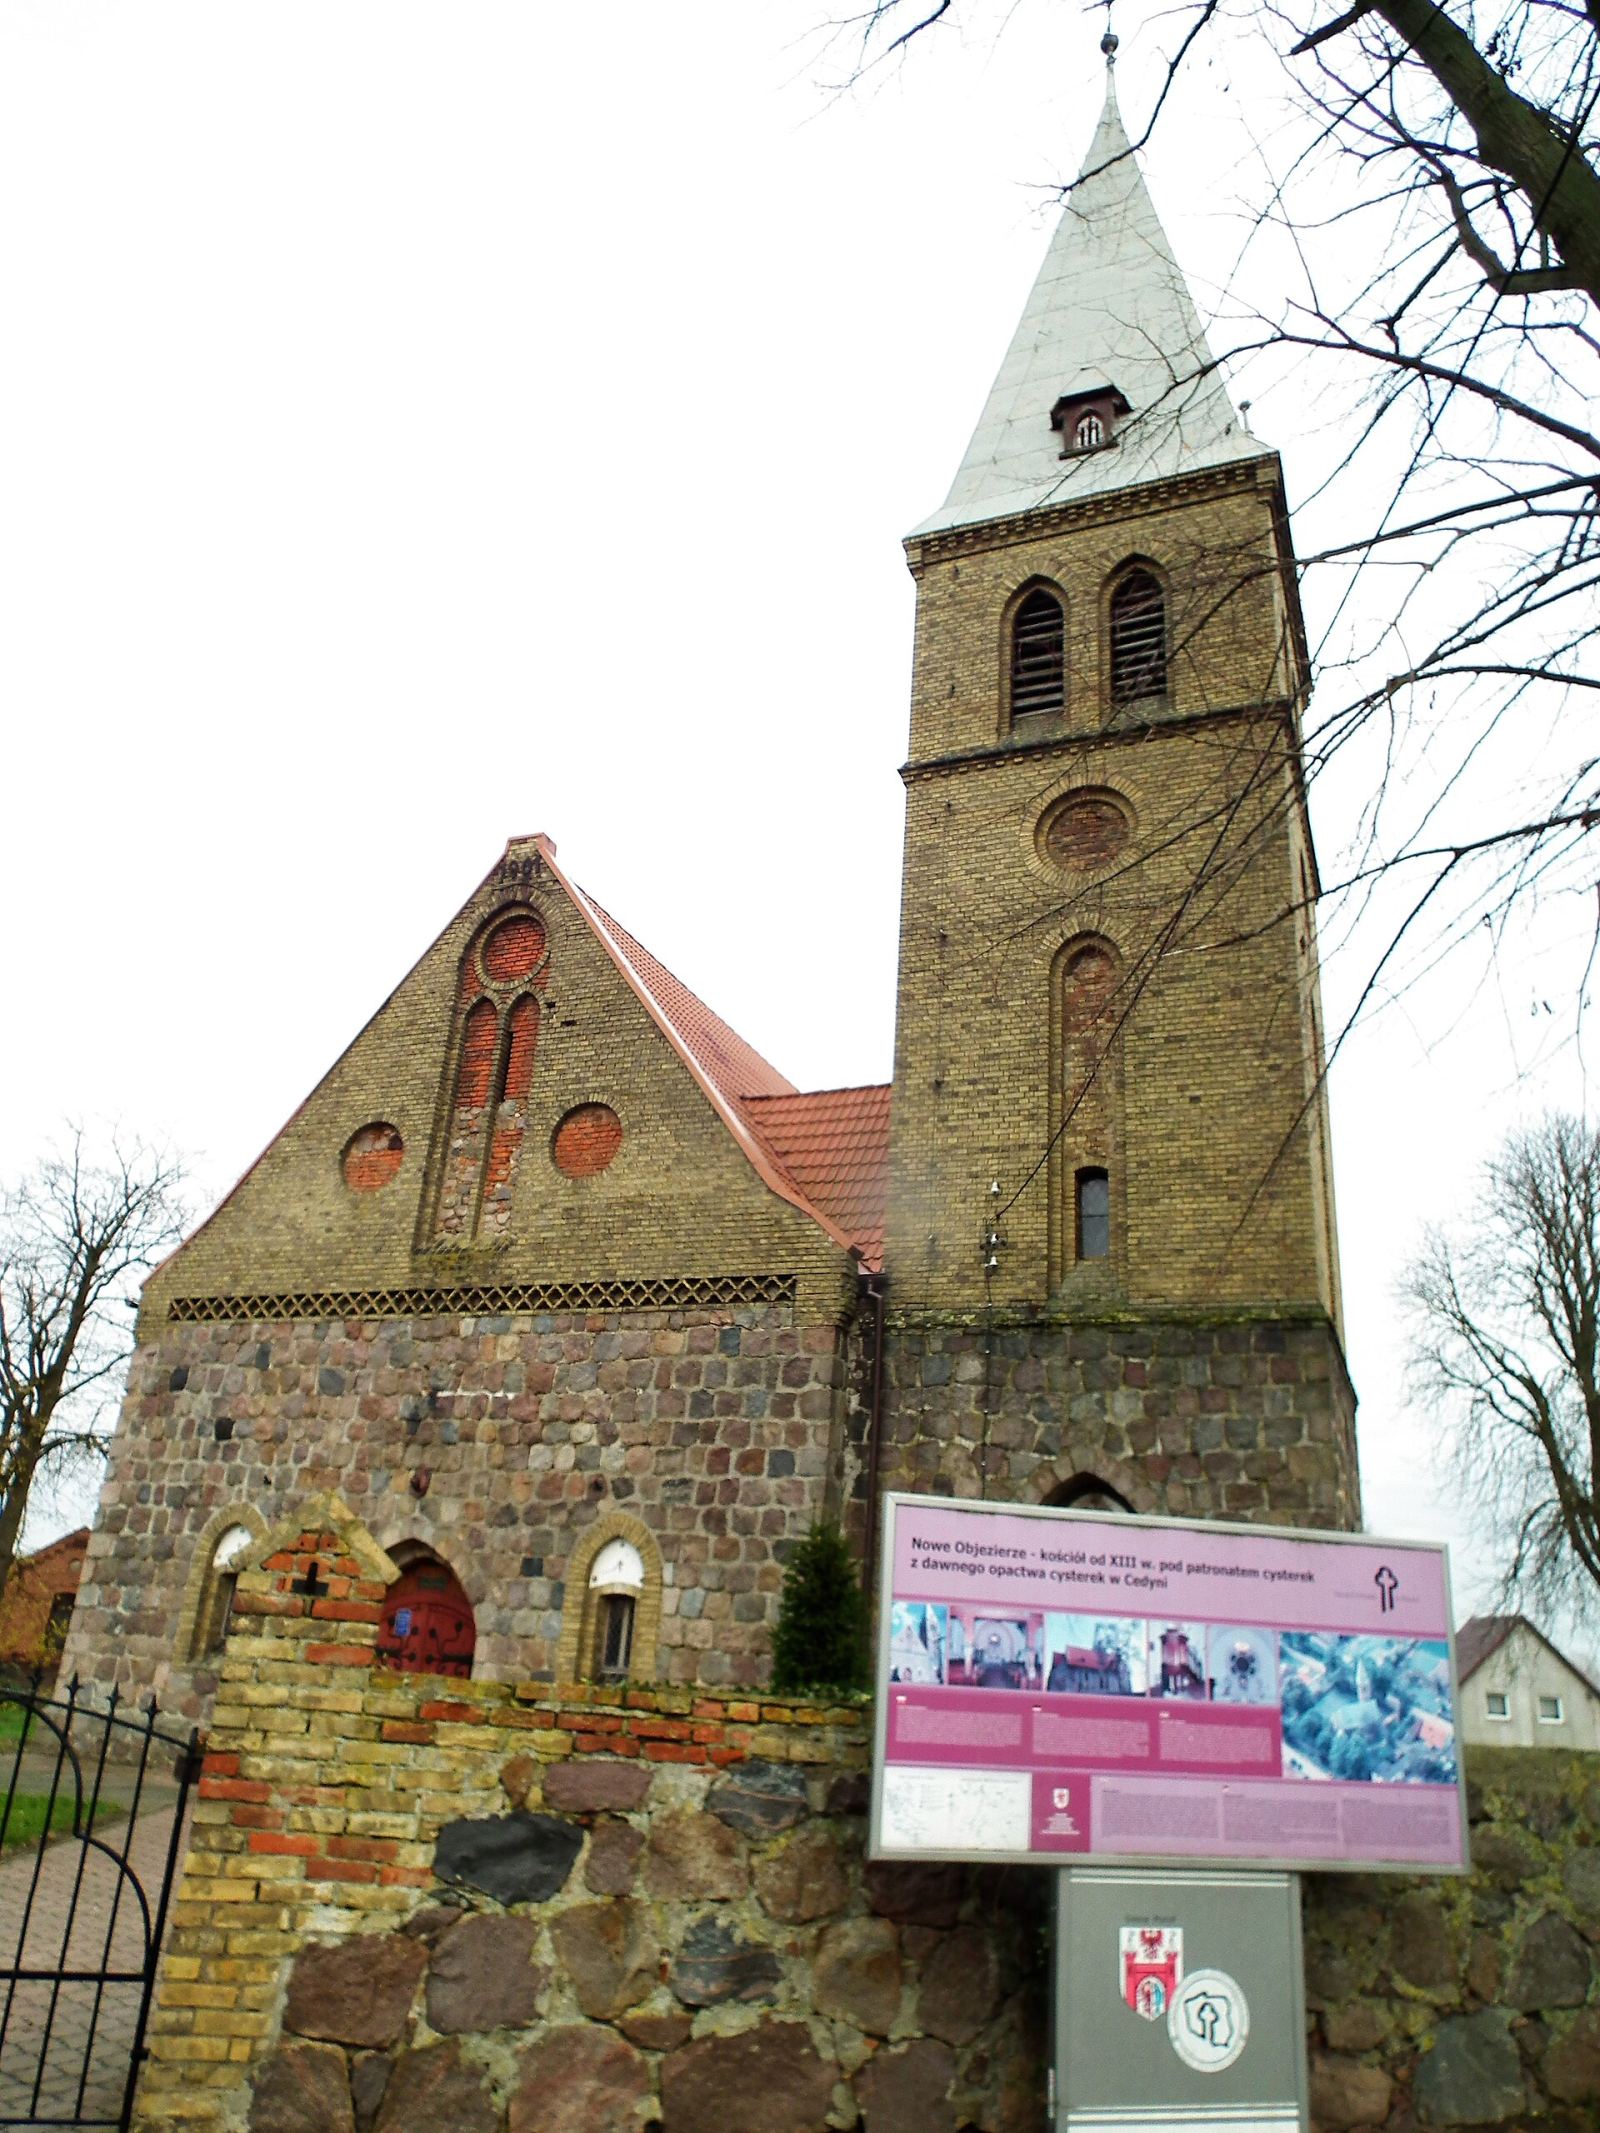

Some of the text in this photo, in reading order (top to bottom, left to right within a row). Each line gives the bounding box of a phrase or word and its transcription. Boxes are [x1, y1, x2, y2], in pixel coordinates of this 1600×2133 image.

[910, 1557, 1168, 1591] z dawnego opactwa cysterek w Cedyni
[911, 1537, 951, 1553] Nowe
[954, 1541, 1027, 1560] Objezierze
[1089, 1553, 1106, 1566] od
[1110, 1555, 1137, 1569] XIII
[1159, 1560, 1183, 1574] pod
[1186, 1563, 1260, 1579] patronatem
[1262, 1567, 1315, 1583] cysterek
